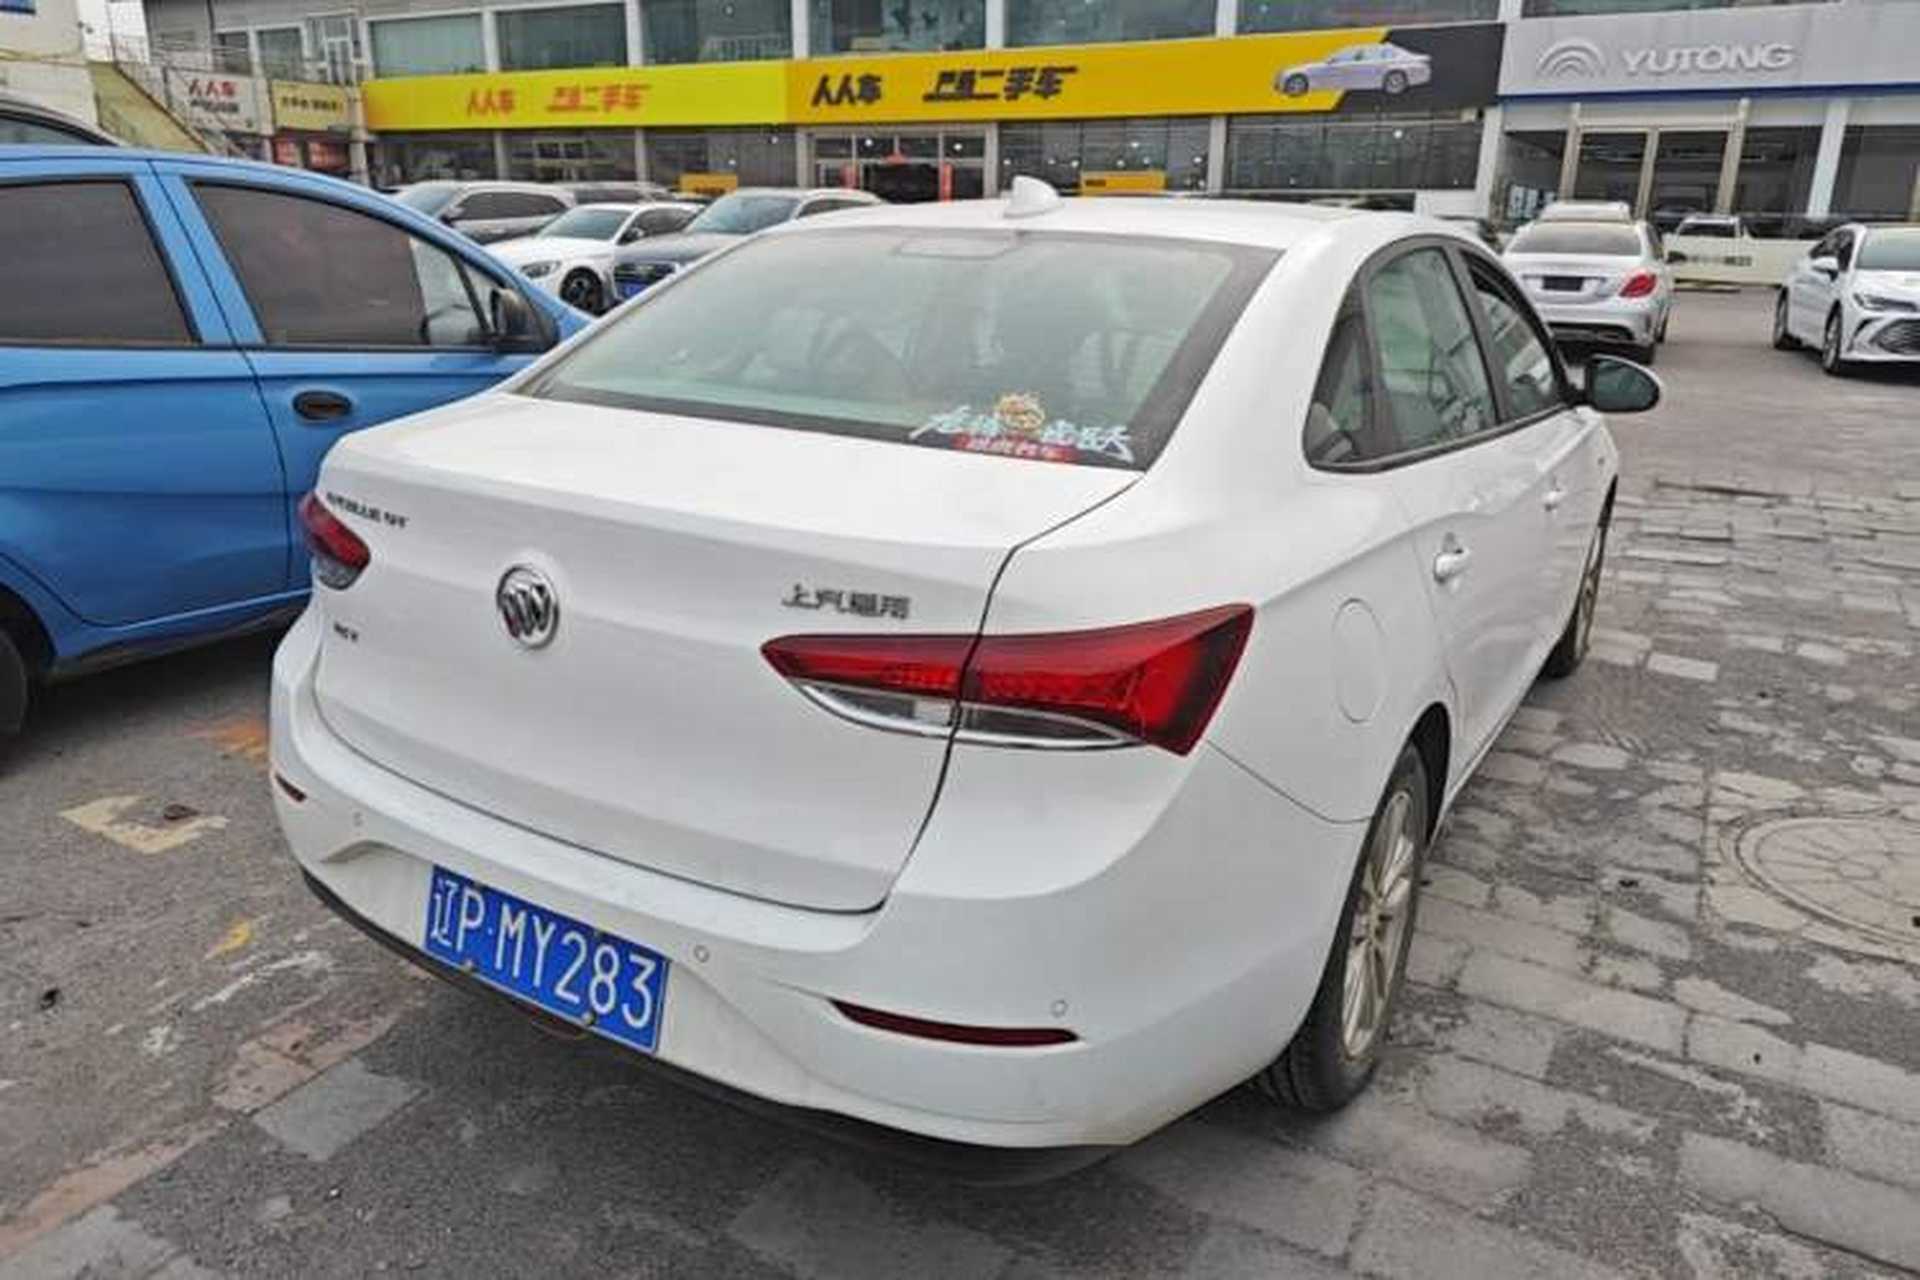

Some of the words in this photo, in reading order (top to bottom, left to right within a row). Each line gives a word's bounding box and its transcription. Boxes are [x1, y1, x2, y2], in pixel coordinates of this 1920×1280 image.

[1622, 43, 1794, 76] YUTONG
[811, 74, 882, 107] 人人车
